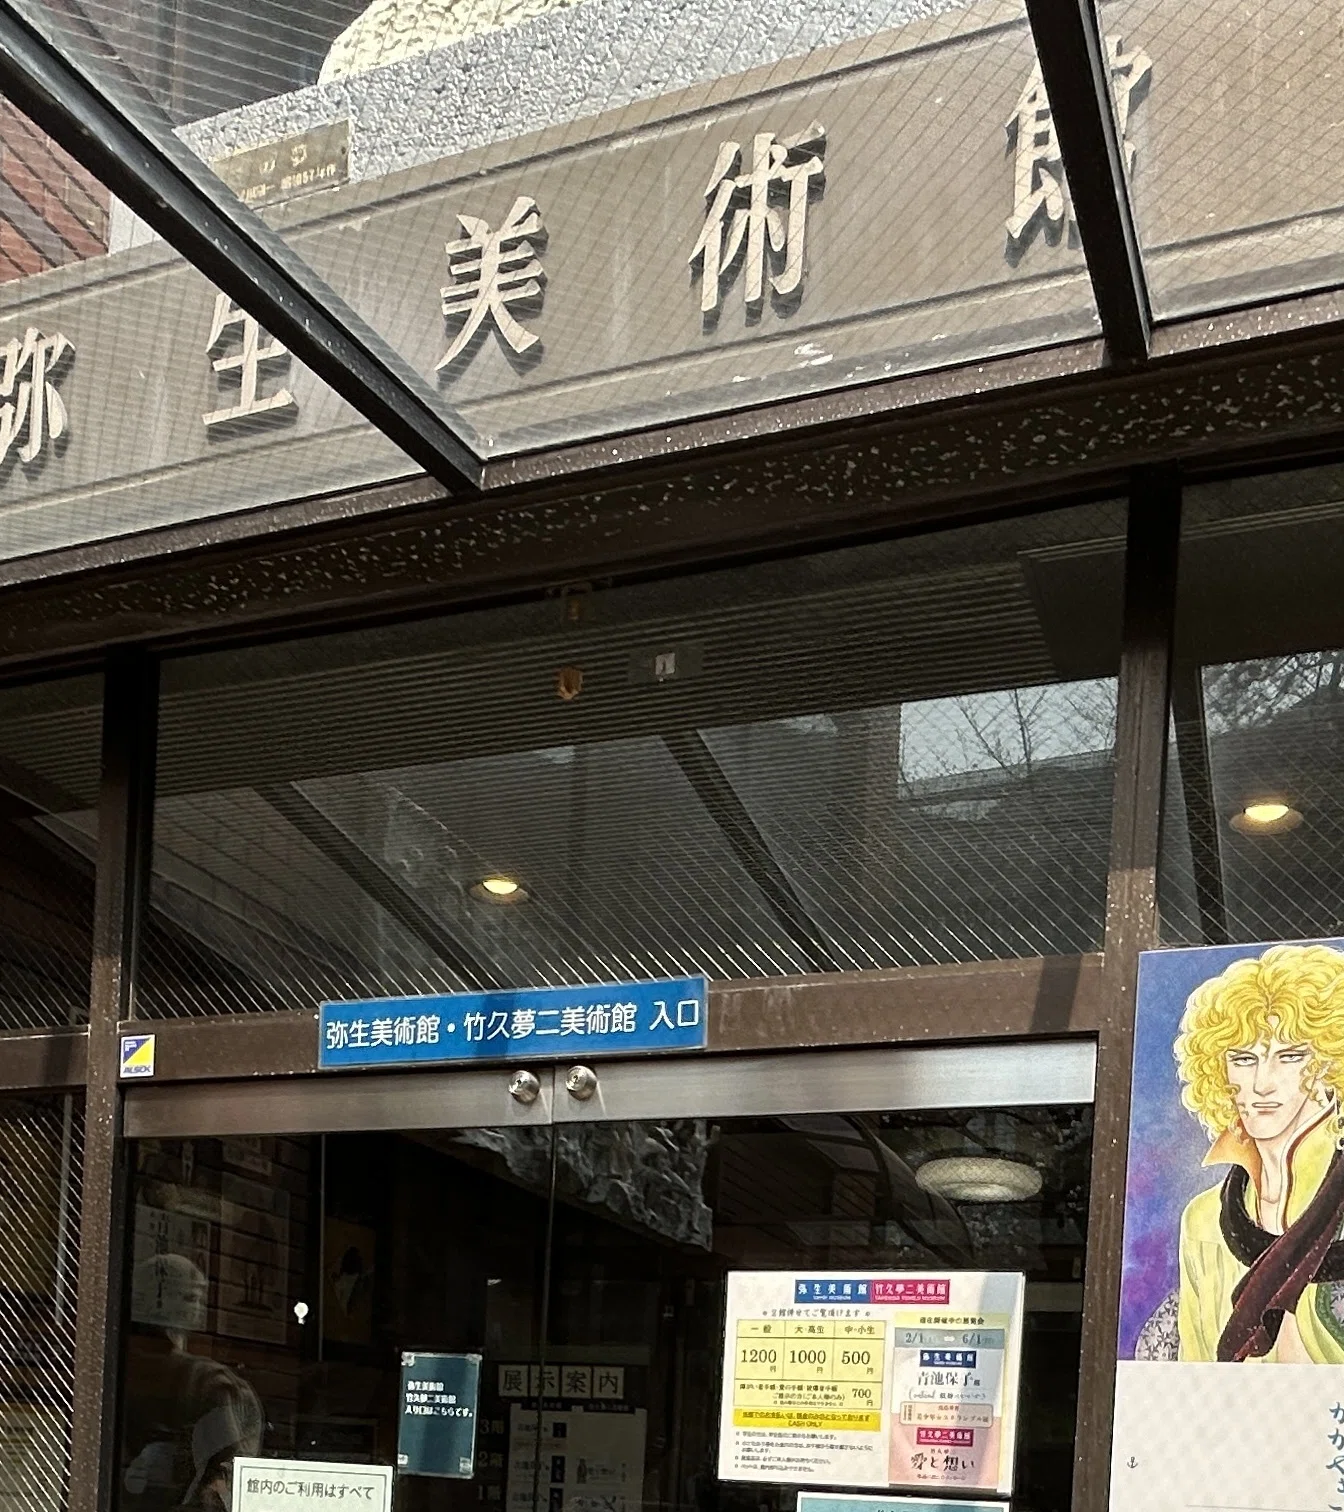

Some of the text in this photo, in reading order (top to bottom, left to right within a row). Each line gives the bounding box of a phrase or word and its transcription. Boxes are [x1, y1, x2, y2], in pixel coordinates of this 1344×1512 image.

[325, 999, 700, 1050] 弥生美術館・竹久夢二美術館 入口
[741, 1349, 777, 1363] 1200
[789, 1349, 826, 1364] 1000
[841, 1351, 871, 1365] 500
[502, 1369, 619, 1395] 展示案内
[852, 1388, 872, 1399] 700
[246, 1478, 375, 1500] 館内のご利用はすべて
